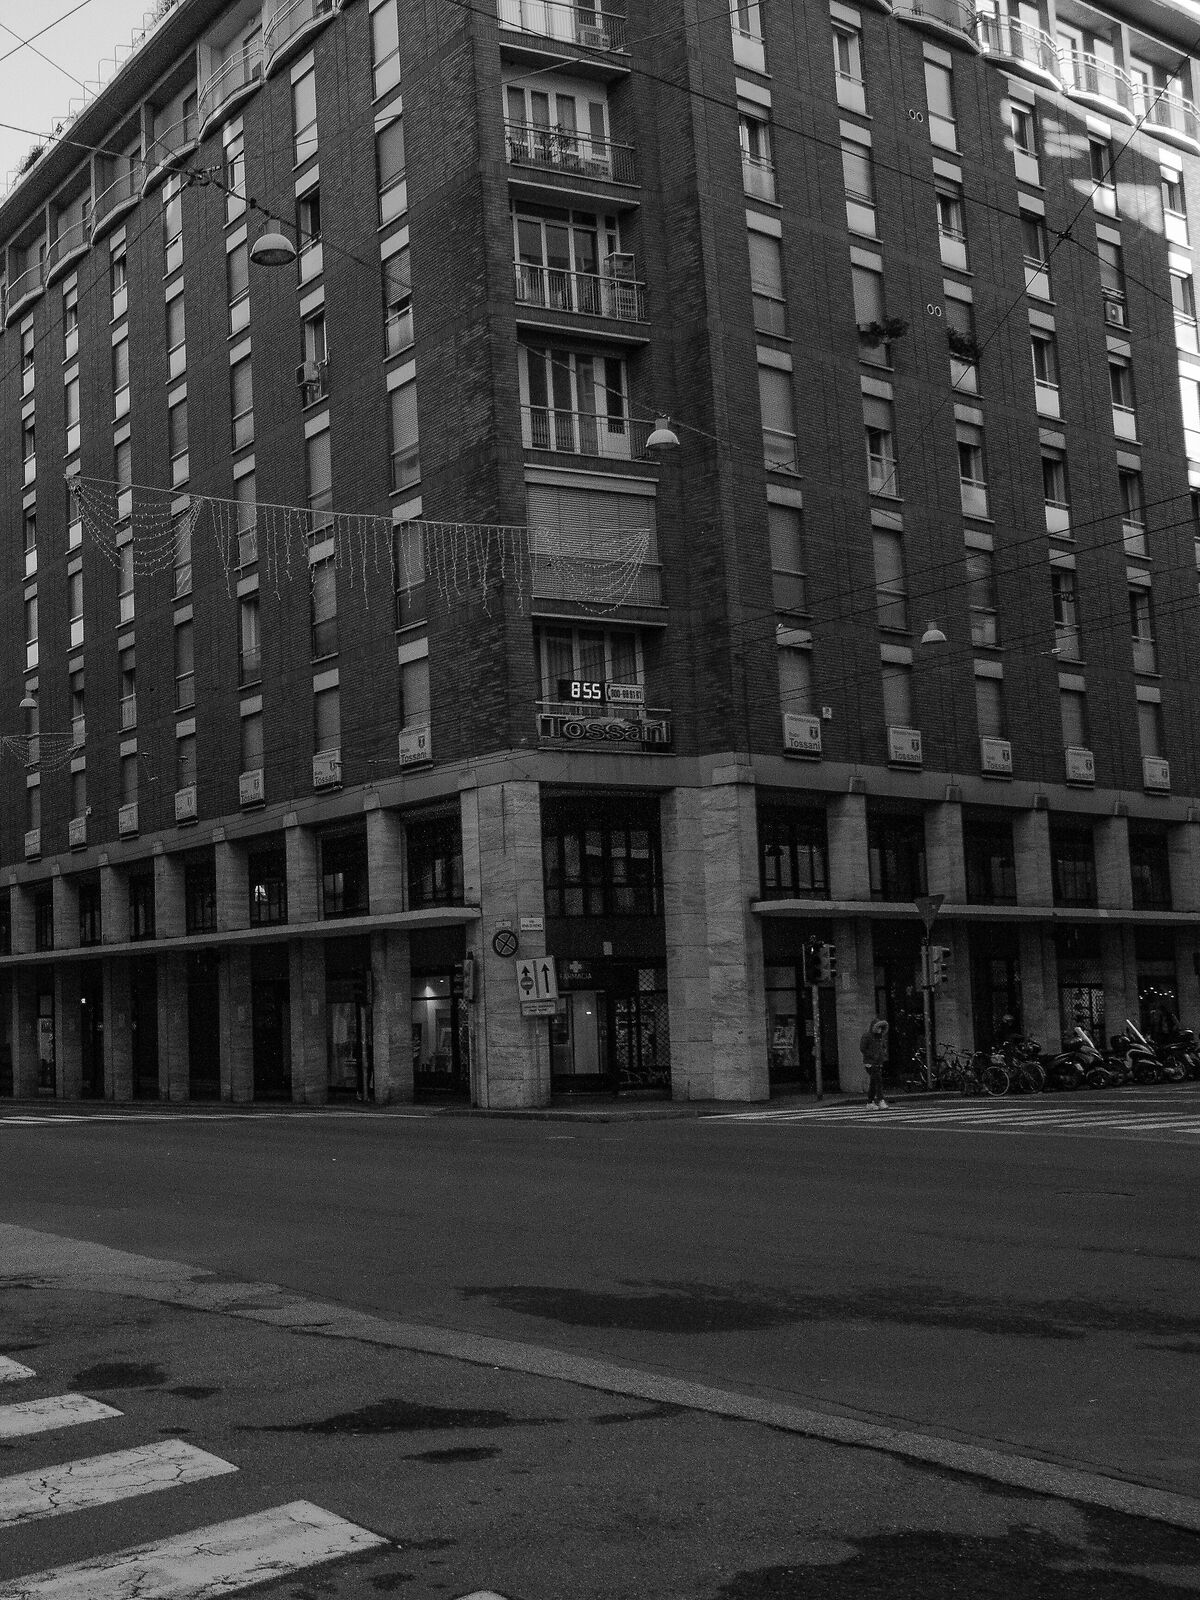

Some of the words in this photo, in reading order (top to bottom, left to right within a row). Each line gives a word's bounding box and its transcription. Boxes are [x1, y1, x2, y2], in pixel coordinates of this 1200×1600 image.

[540, 715, 671, 743] Tossani
[790, 737, 820, 750] Tossani
[400, 751, 427, 764] Tossani
[894, 750, 920, 761] Tossani
